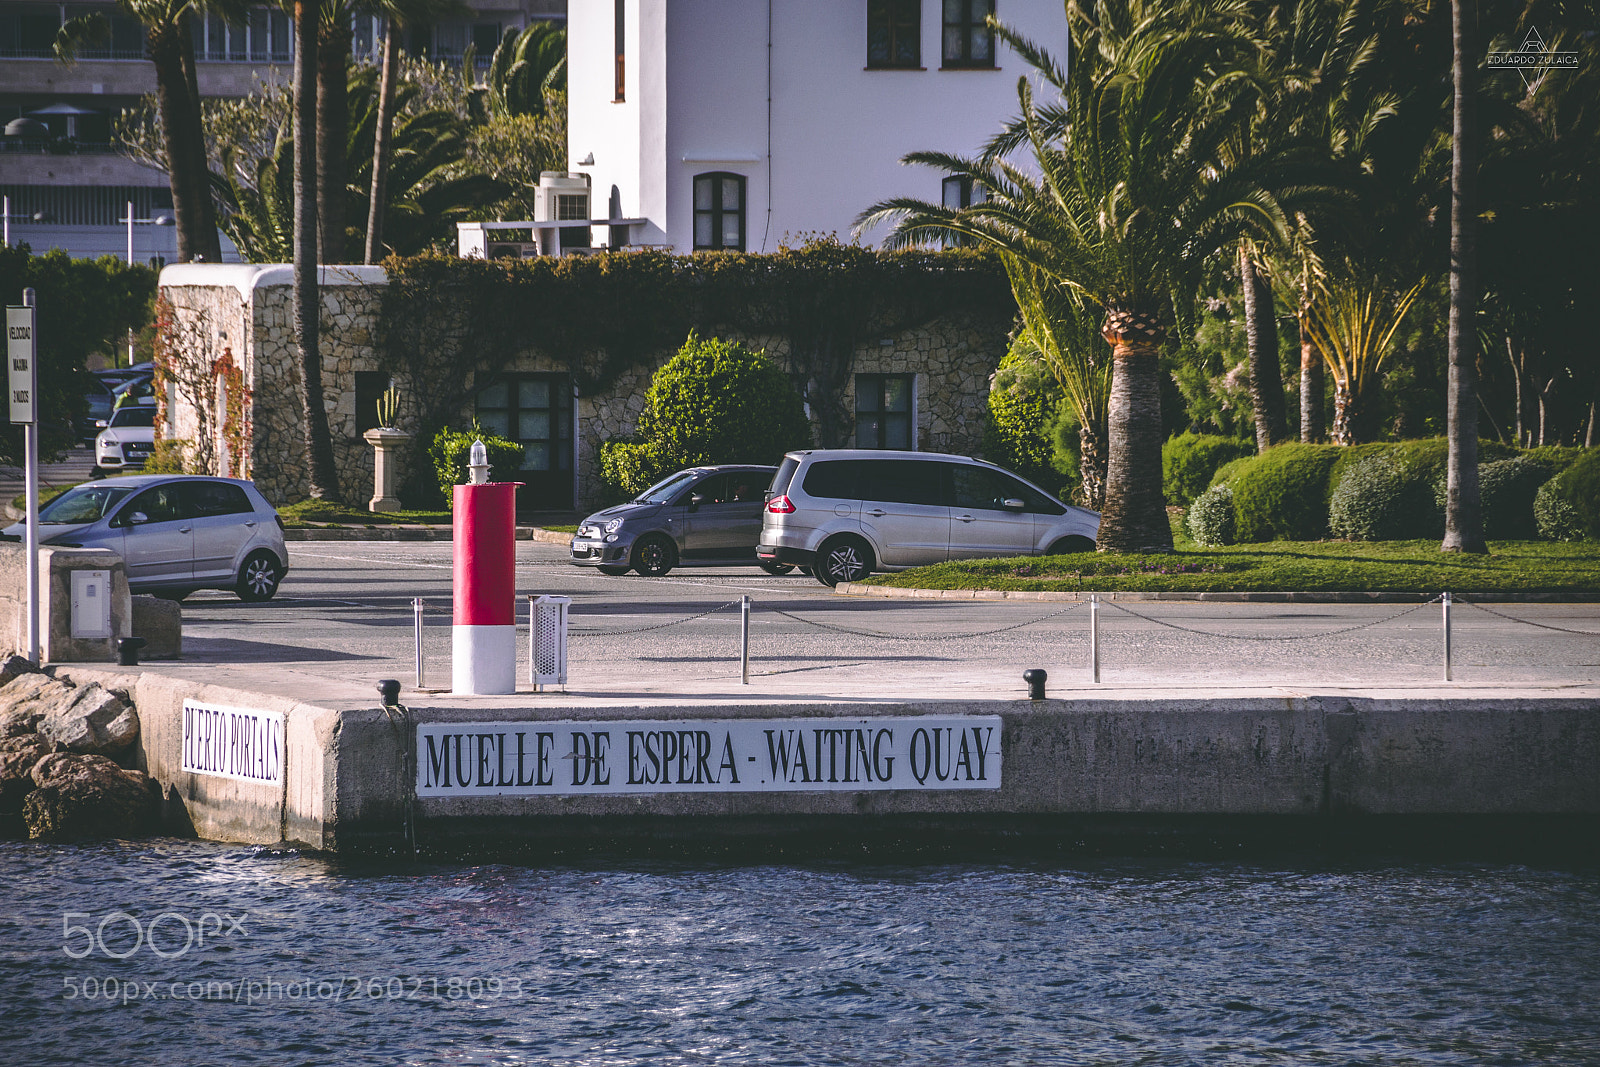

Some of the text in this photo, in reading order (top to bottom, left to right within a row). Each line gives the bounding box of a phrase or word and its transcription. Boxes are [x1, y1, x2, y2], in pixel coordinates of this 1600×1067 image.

[9, 326, 31, 340] VELOCIDAD
[184, 706, 280, 781] PUERTO PORTALS
[424, 732, 554, 788] MUELLE
[570, 731, 611, 786] DE
[625, 730, 741, 784] ESPERA
[763, 728, 896, 783] WAITING
[909, 727, 994, 785] QUAY
